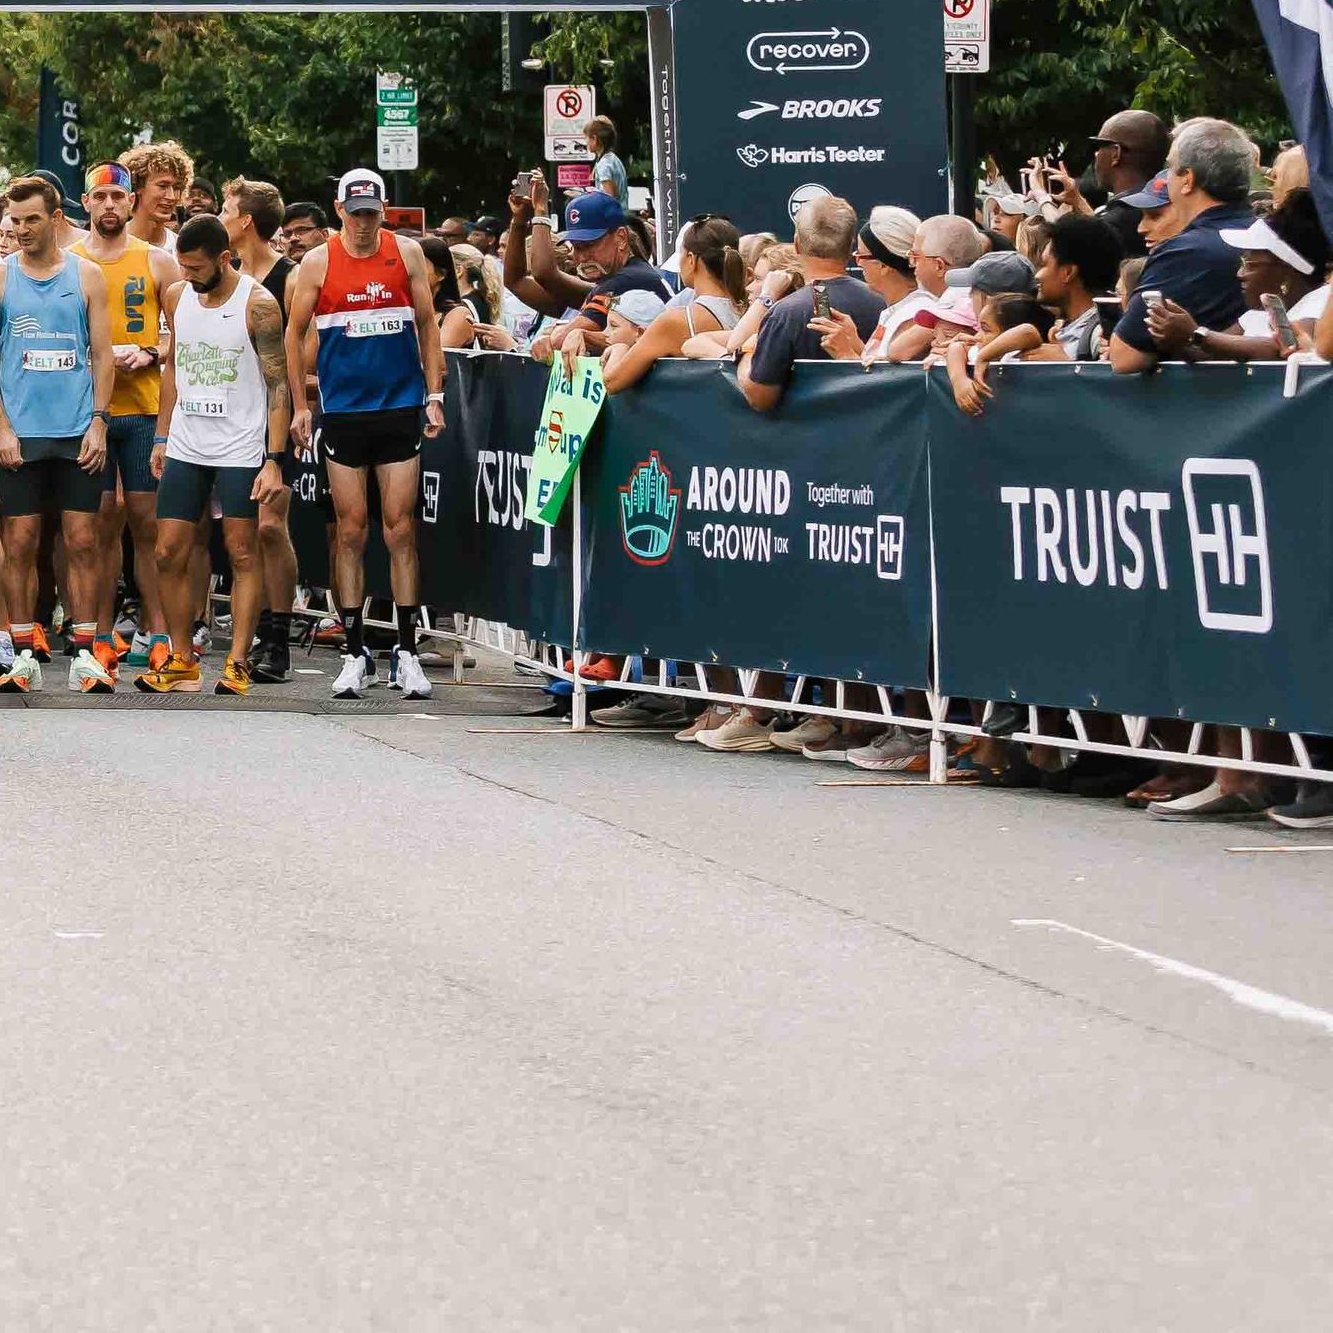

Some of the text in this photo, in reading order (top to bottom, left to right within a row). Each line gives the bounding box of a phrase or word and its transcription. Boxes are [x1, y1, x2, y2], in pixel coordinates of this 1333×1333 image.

[781, 98, 883, 119] BROOKS
[660, 65, 675, 244] Together with
[771, 145, 885, 164] Harris Teeter
[381, 320, 400, 331] 163
[58, 356, 74, 368] 143
[582, 369, 603, 405] is
[205, 403, 223, 414] 131
[687, 465, 791, 516] AROUND
[806, 481, 875, 510] Together with
[686, 523, 789, 563] THE CROWN 10K
[806, 522, 874, 565] TRUIST
[1000, 486, 1171, 590] TRUIST
